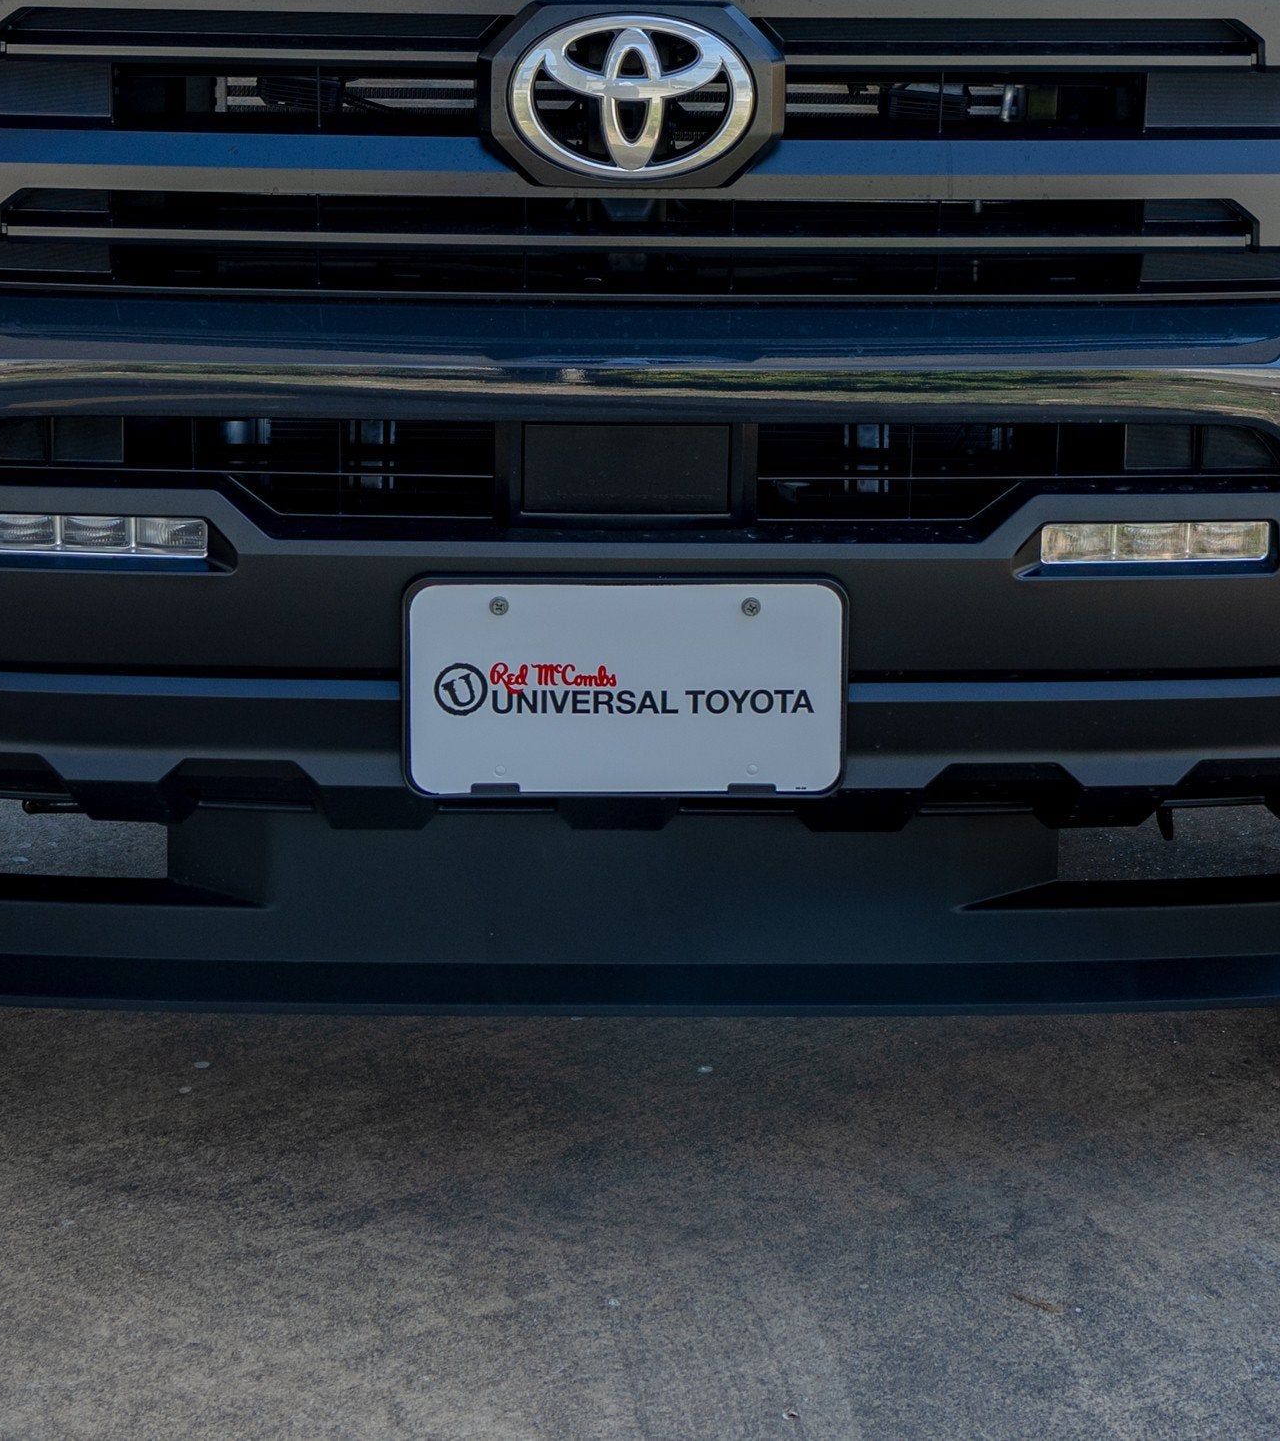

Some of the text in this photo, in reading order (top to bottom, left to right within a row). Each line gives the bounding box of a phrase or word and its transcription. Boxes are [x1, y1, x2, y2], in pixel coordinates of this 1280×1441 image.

[489, 662, 617, 694] Red McCombs
[491, 689, 815, 715] UNIVERSAL TOYOTA
